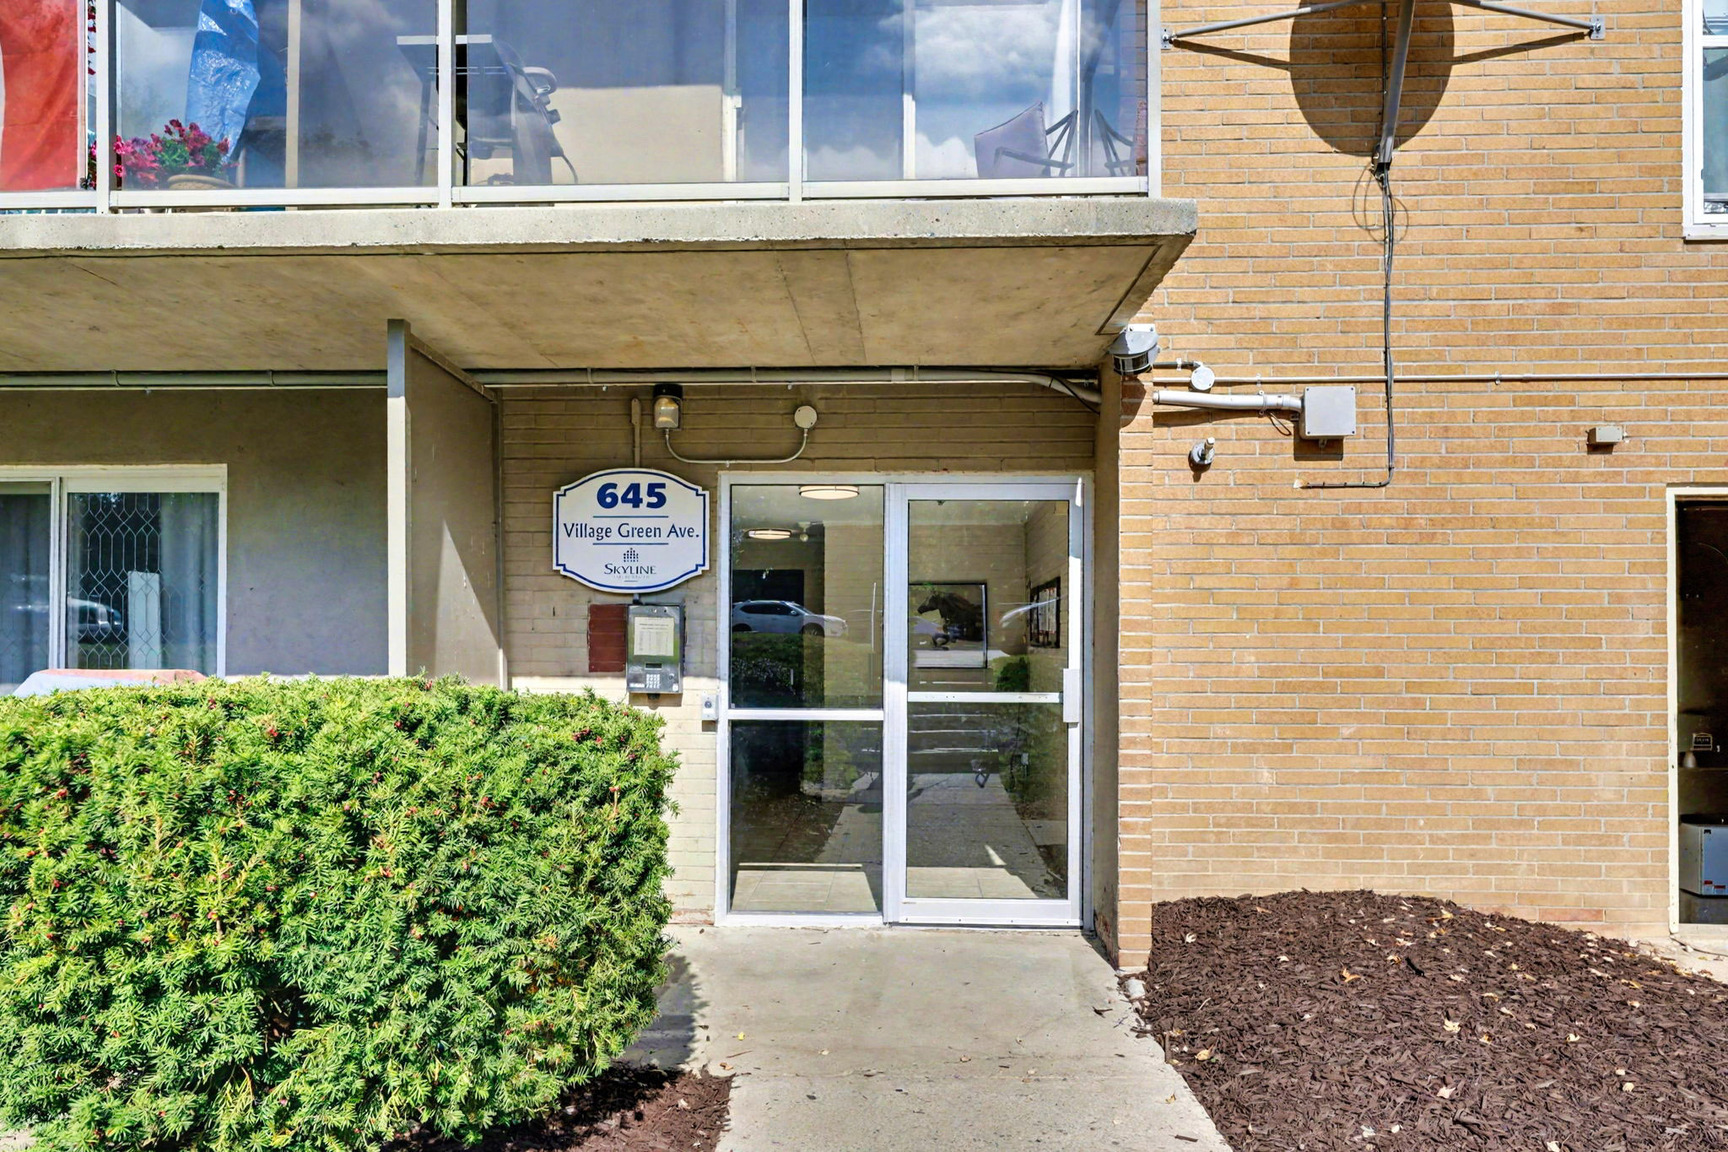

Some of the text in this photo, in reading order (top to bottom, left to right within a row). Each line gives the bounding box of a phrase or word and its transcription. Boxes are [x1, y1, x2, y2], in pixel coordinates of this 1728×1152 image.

[596, 482, 667, 509] 645
[563, 522, 700, 541] Village Green Ave.
[603, 563, 657, 575] SKYLINE
